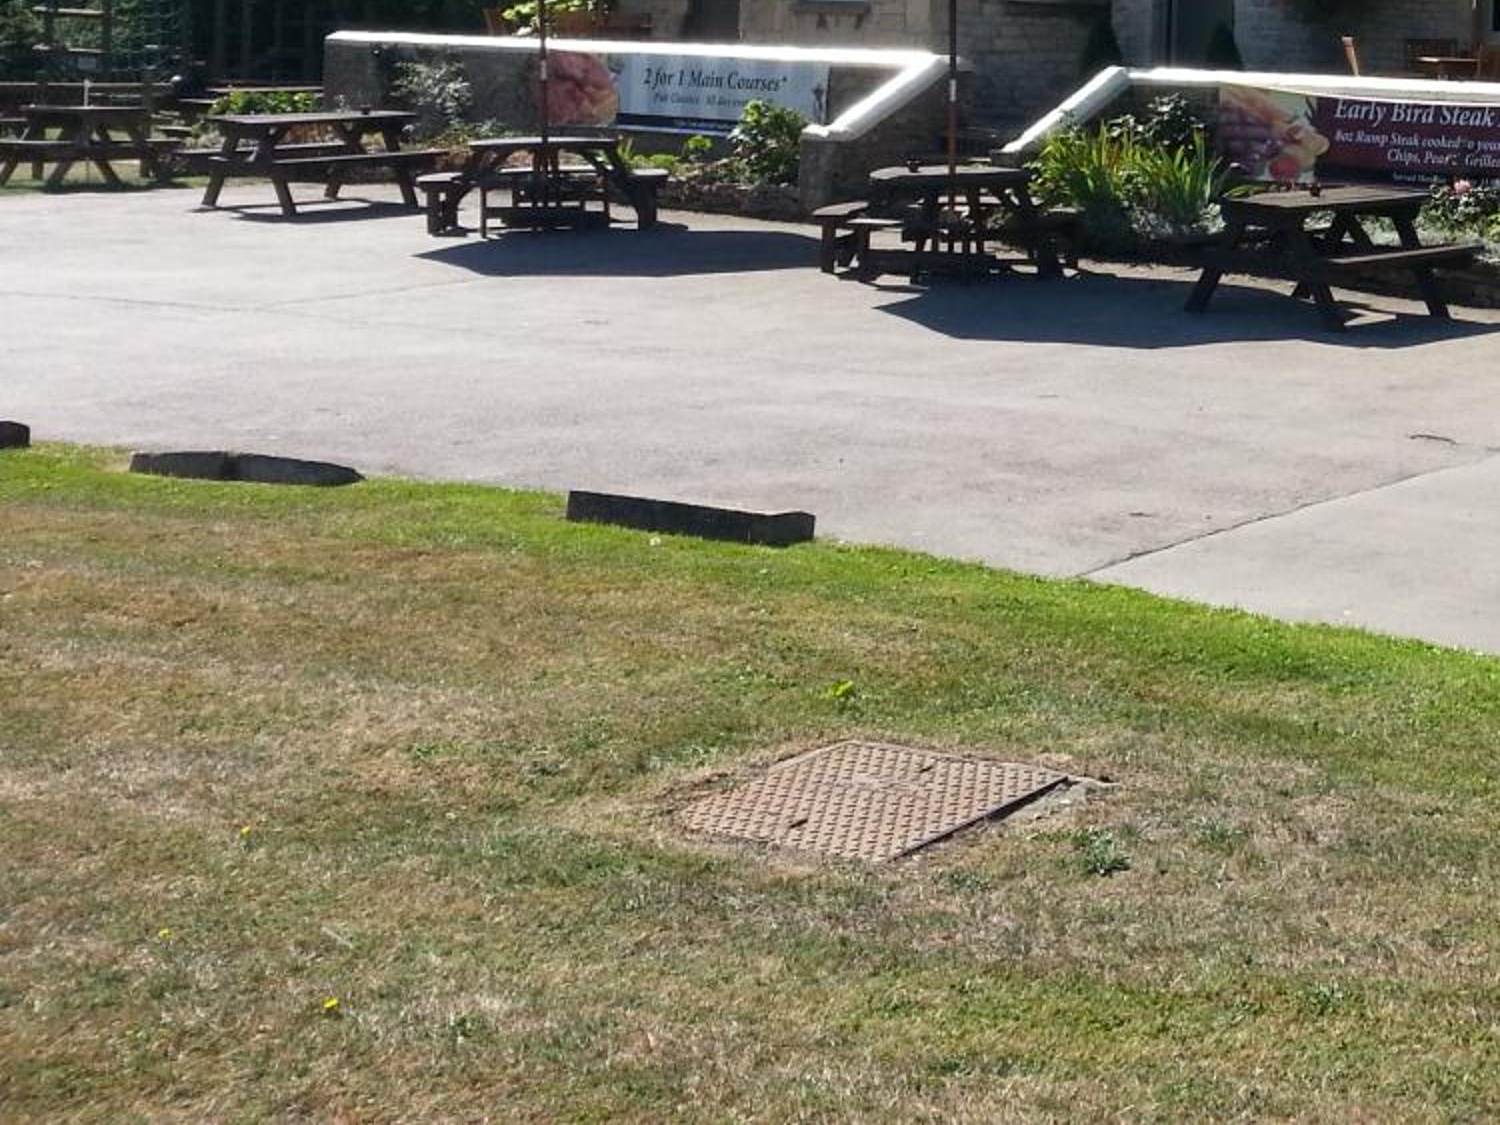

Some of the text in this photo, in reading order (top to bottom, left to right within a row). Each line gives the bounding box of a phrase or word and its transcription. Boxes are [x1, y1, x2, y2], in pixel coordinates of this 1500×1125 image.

[643, 68, 652, 85] 2
[652, 70, 674, 91] for
[677, 69, 685, 86] 1
[688, 70, 723, 90] Main
[1335, 99, 1387, 127] Early
[1391, 103, 1435, 124] Bird
[1439, 106, 1496, 127] Steak
[1355, 130, 1389, 147] Rump
[1390, 132, 1419, 147] Steak
[1421, 134, 1461, 149] cooked
